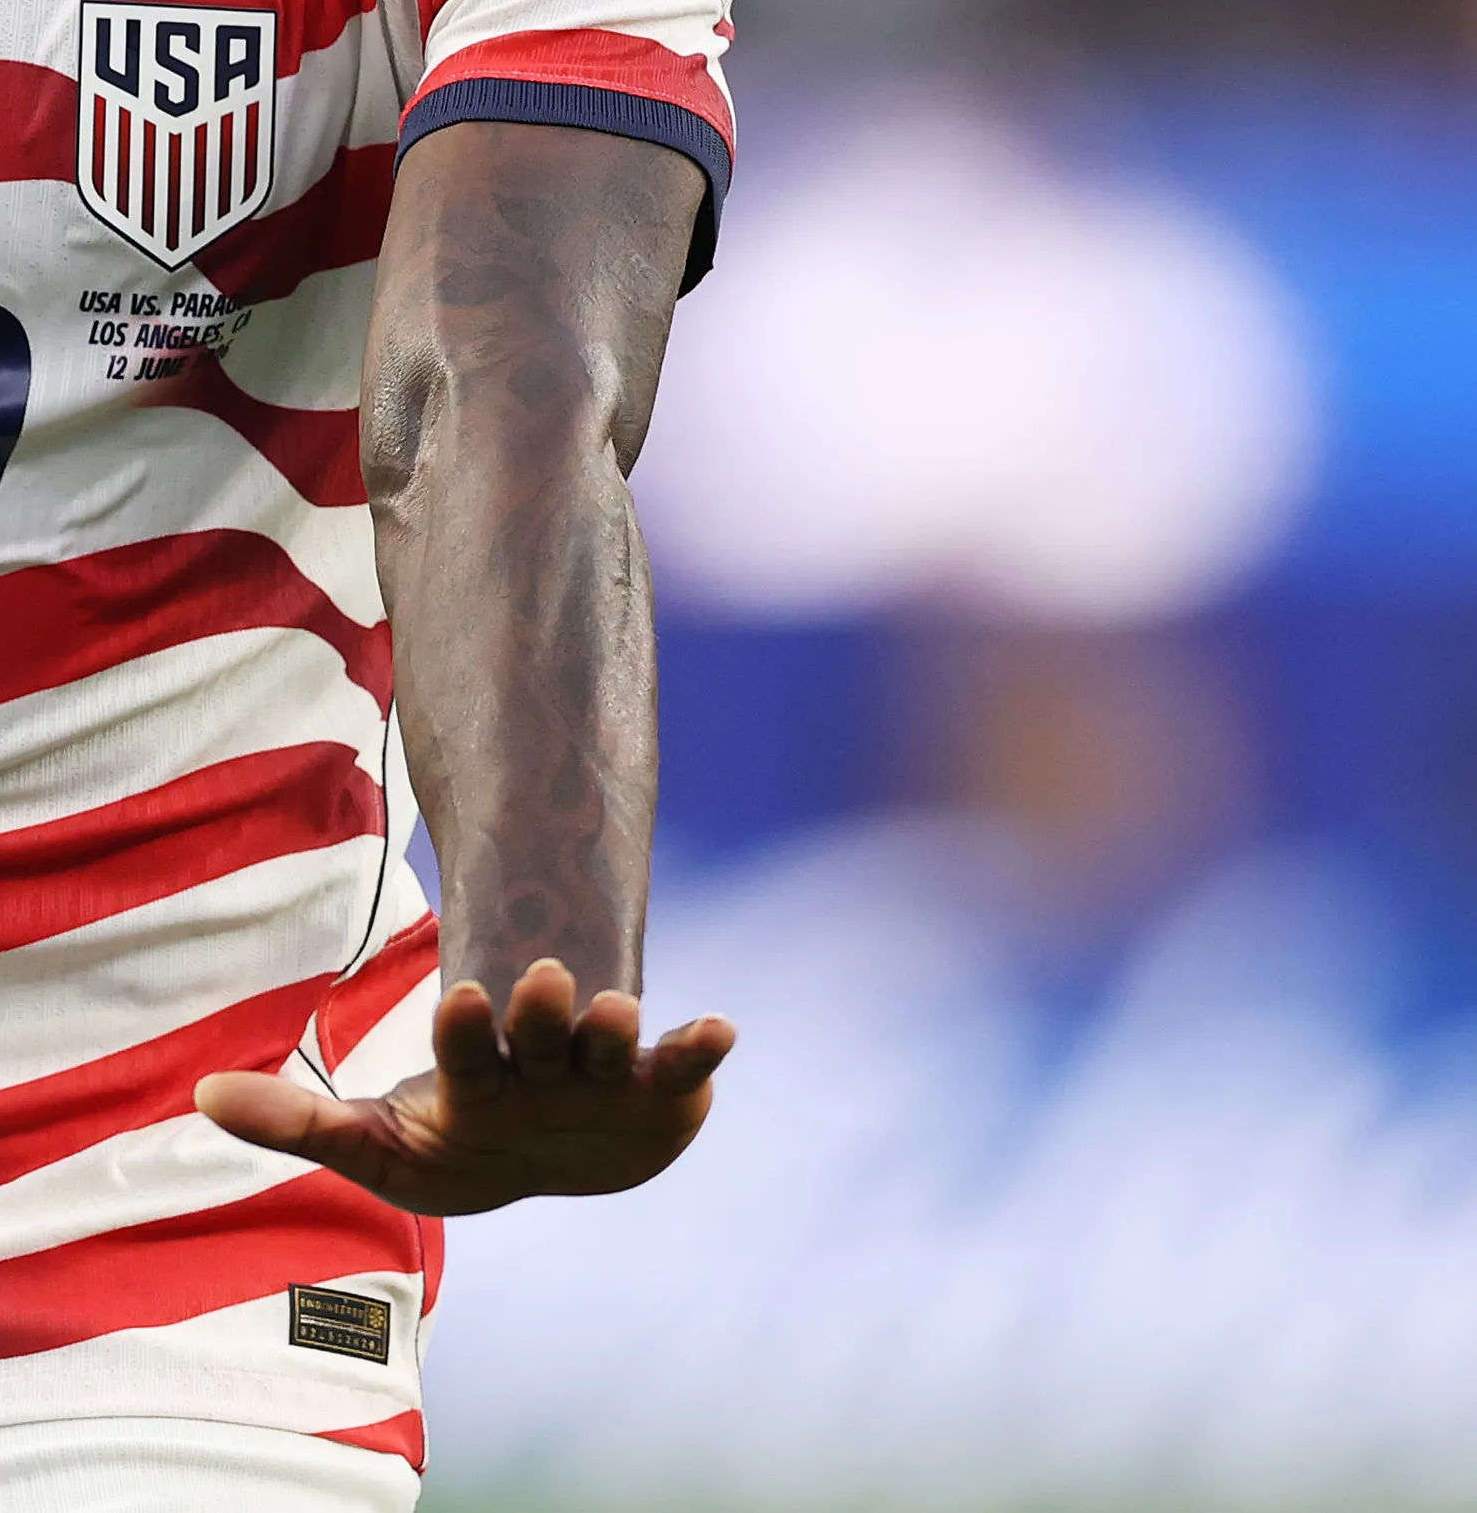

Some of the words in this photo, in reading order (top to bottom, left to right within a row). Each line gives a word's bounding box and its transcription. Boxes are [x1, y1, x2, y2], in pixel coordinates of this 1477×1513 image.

[95, 17, 262, 118] USA
[79, 290, 122, 314] USA
[130, 293, 162, 317] VS.
[88, 320, 129, 347] LOS
[106, 355, 128, 380] 12
[133, 356, 188, 381] JUNE
